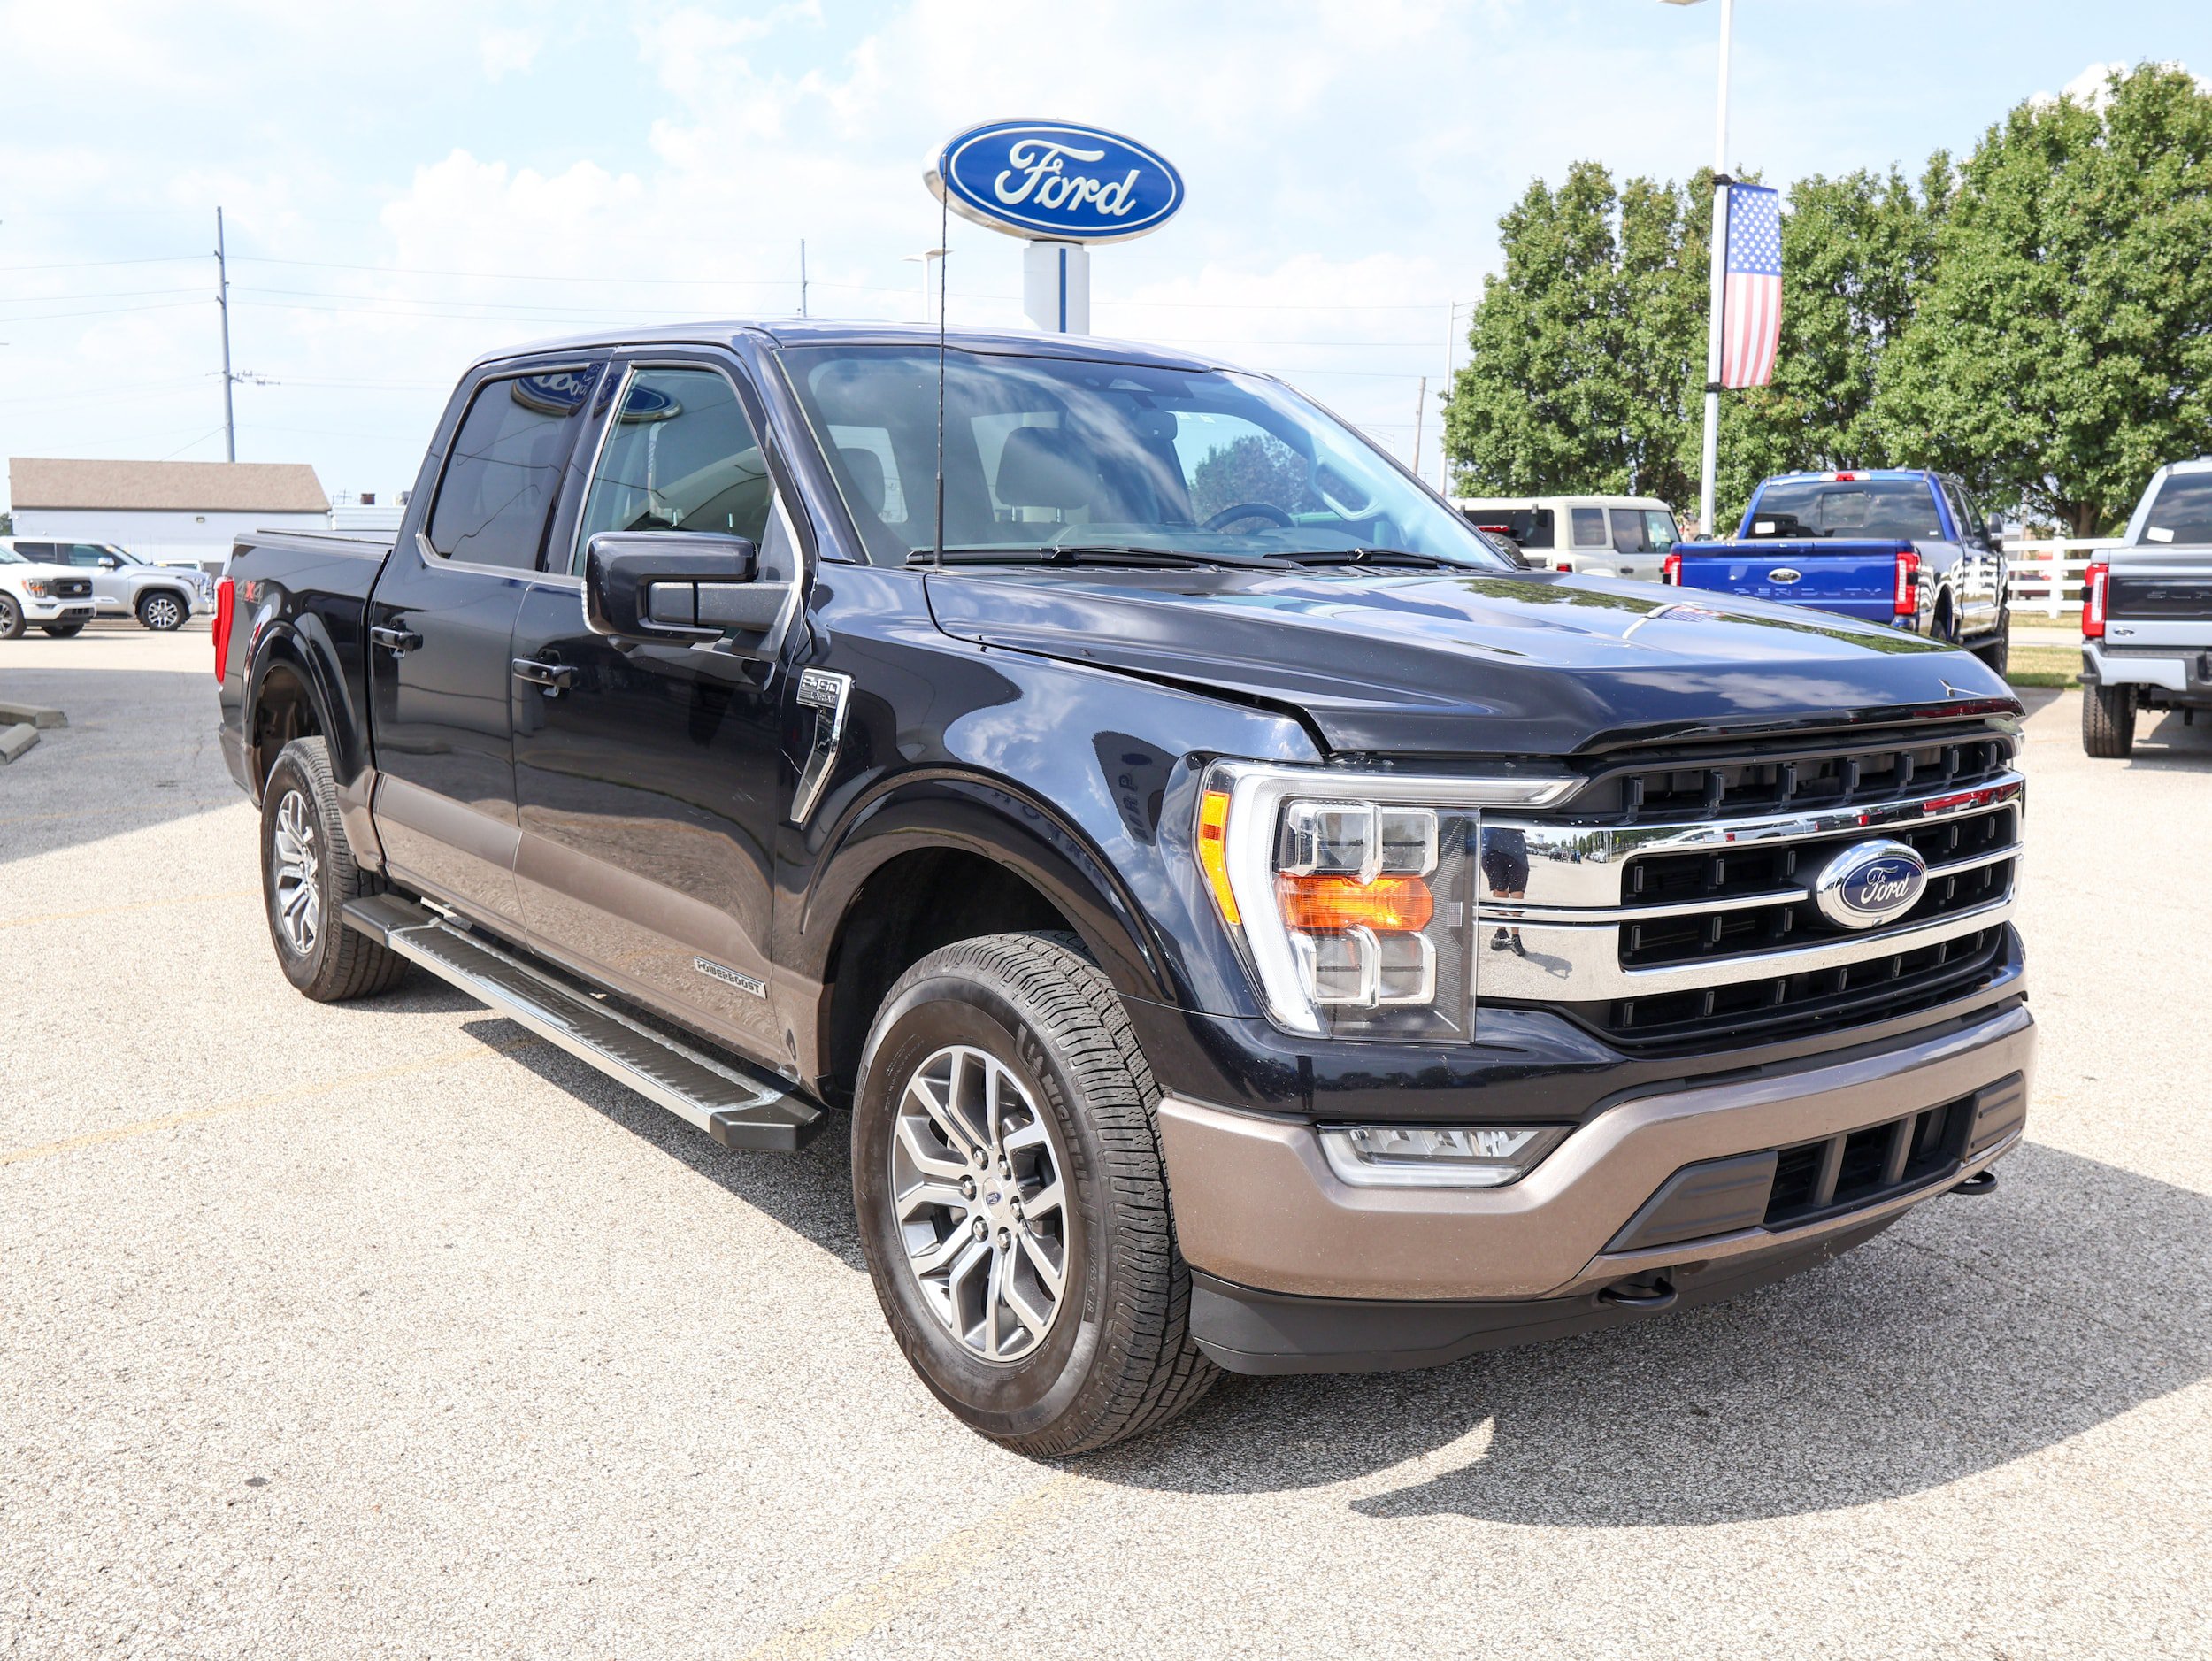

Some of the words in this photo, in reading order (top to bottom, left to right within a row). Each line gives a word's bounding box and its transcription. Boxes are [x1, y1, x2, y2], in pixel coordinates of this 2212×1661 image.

[994, 139, 1141, 217] Ford
[1860, 865, 1911, 904] Ford
[1041, 1073, 1091, 1198] MICHELIN
[1087, 1298, 1095, 1313] 18
